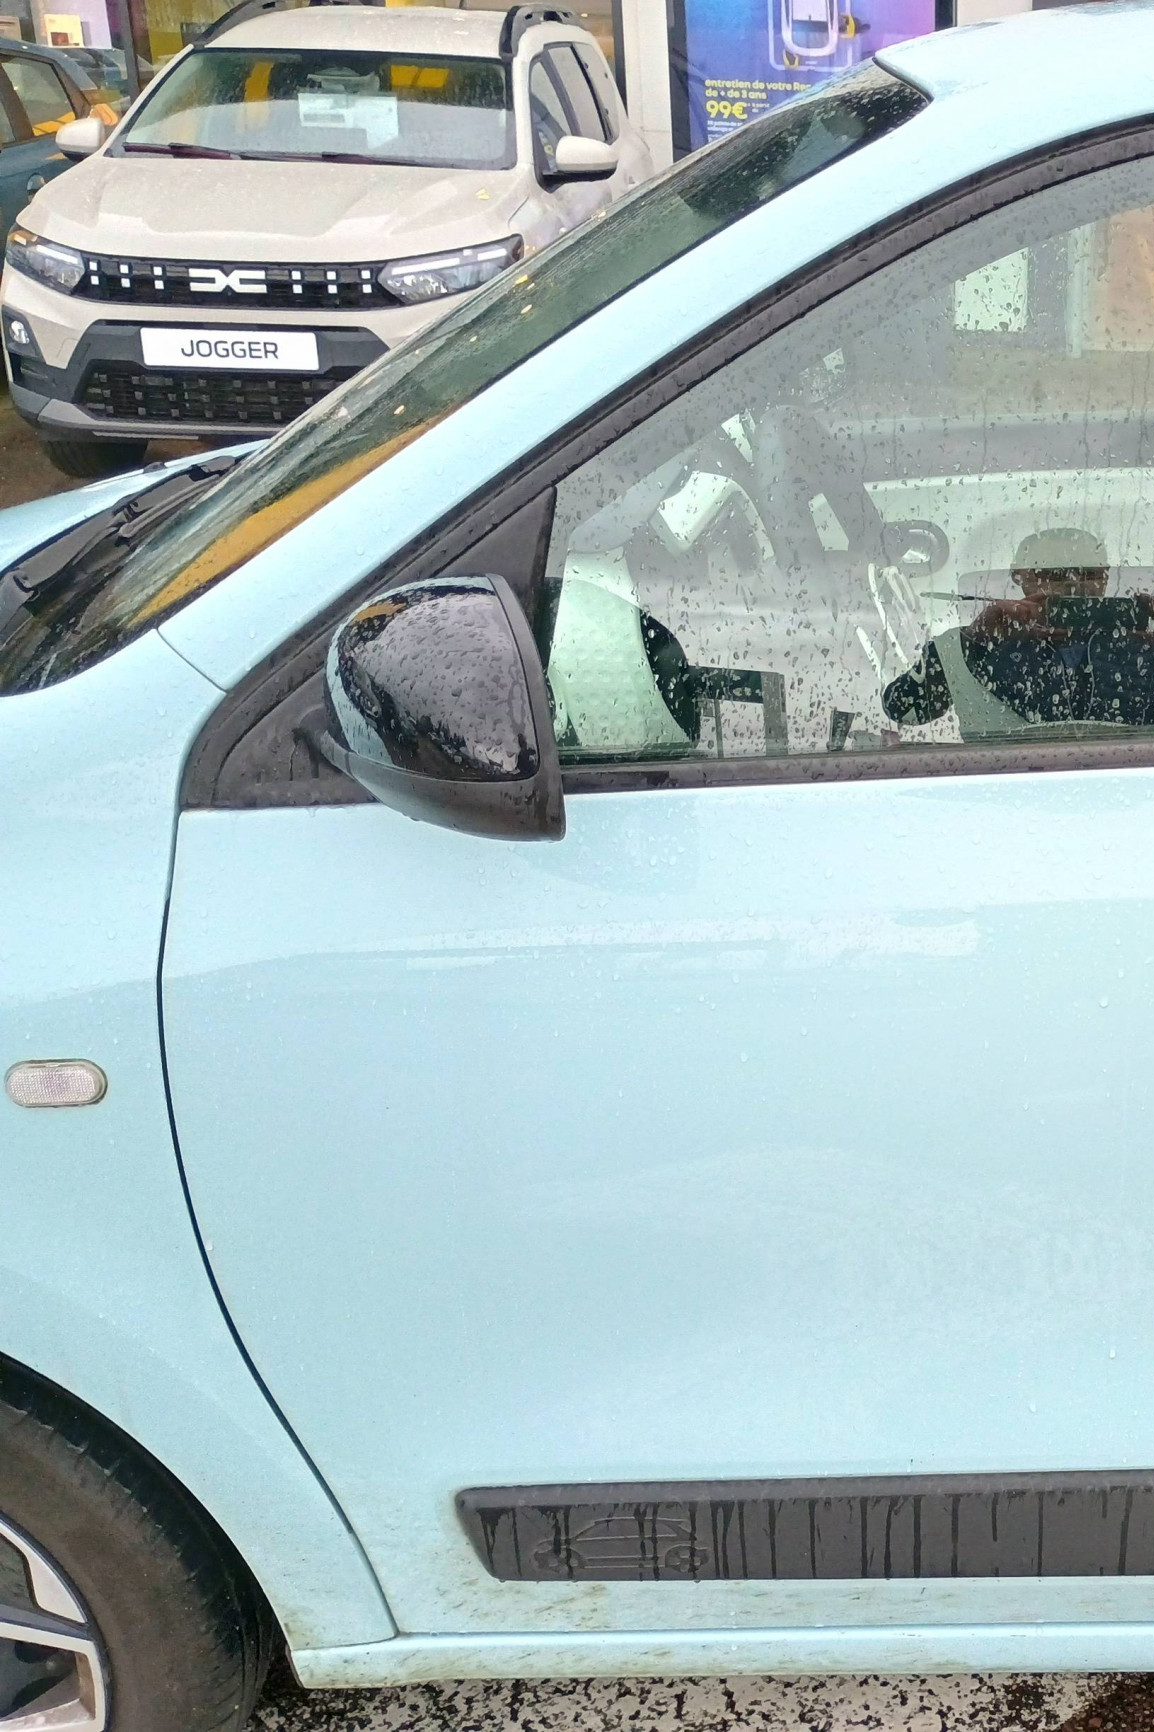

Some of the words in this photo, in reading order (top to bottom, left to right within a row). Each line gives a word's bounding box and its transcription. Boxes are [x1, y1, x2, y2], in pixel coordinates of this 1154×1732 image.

[705, 79, 751, 88] entretien
[752, 80, 765, 90] de
[766, 82, 792, 91] votre
[705, 88, 719, 97] de
[727, 89, 741, 98] de
[181, 340, 279, 360] JOGGER
